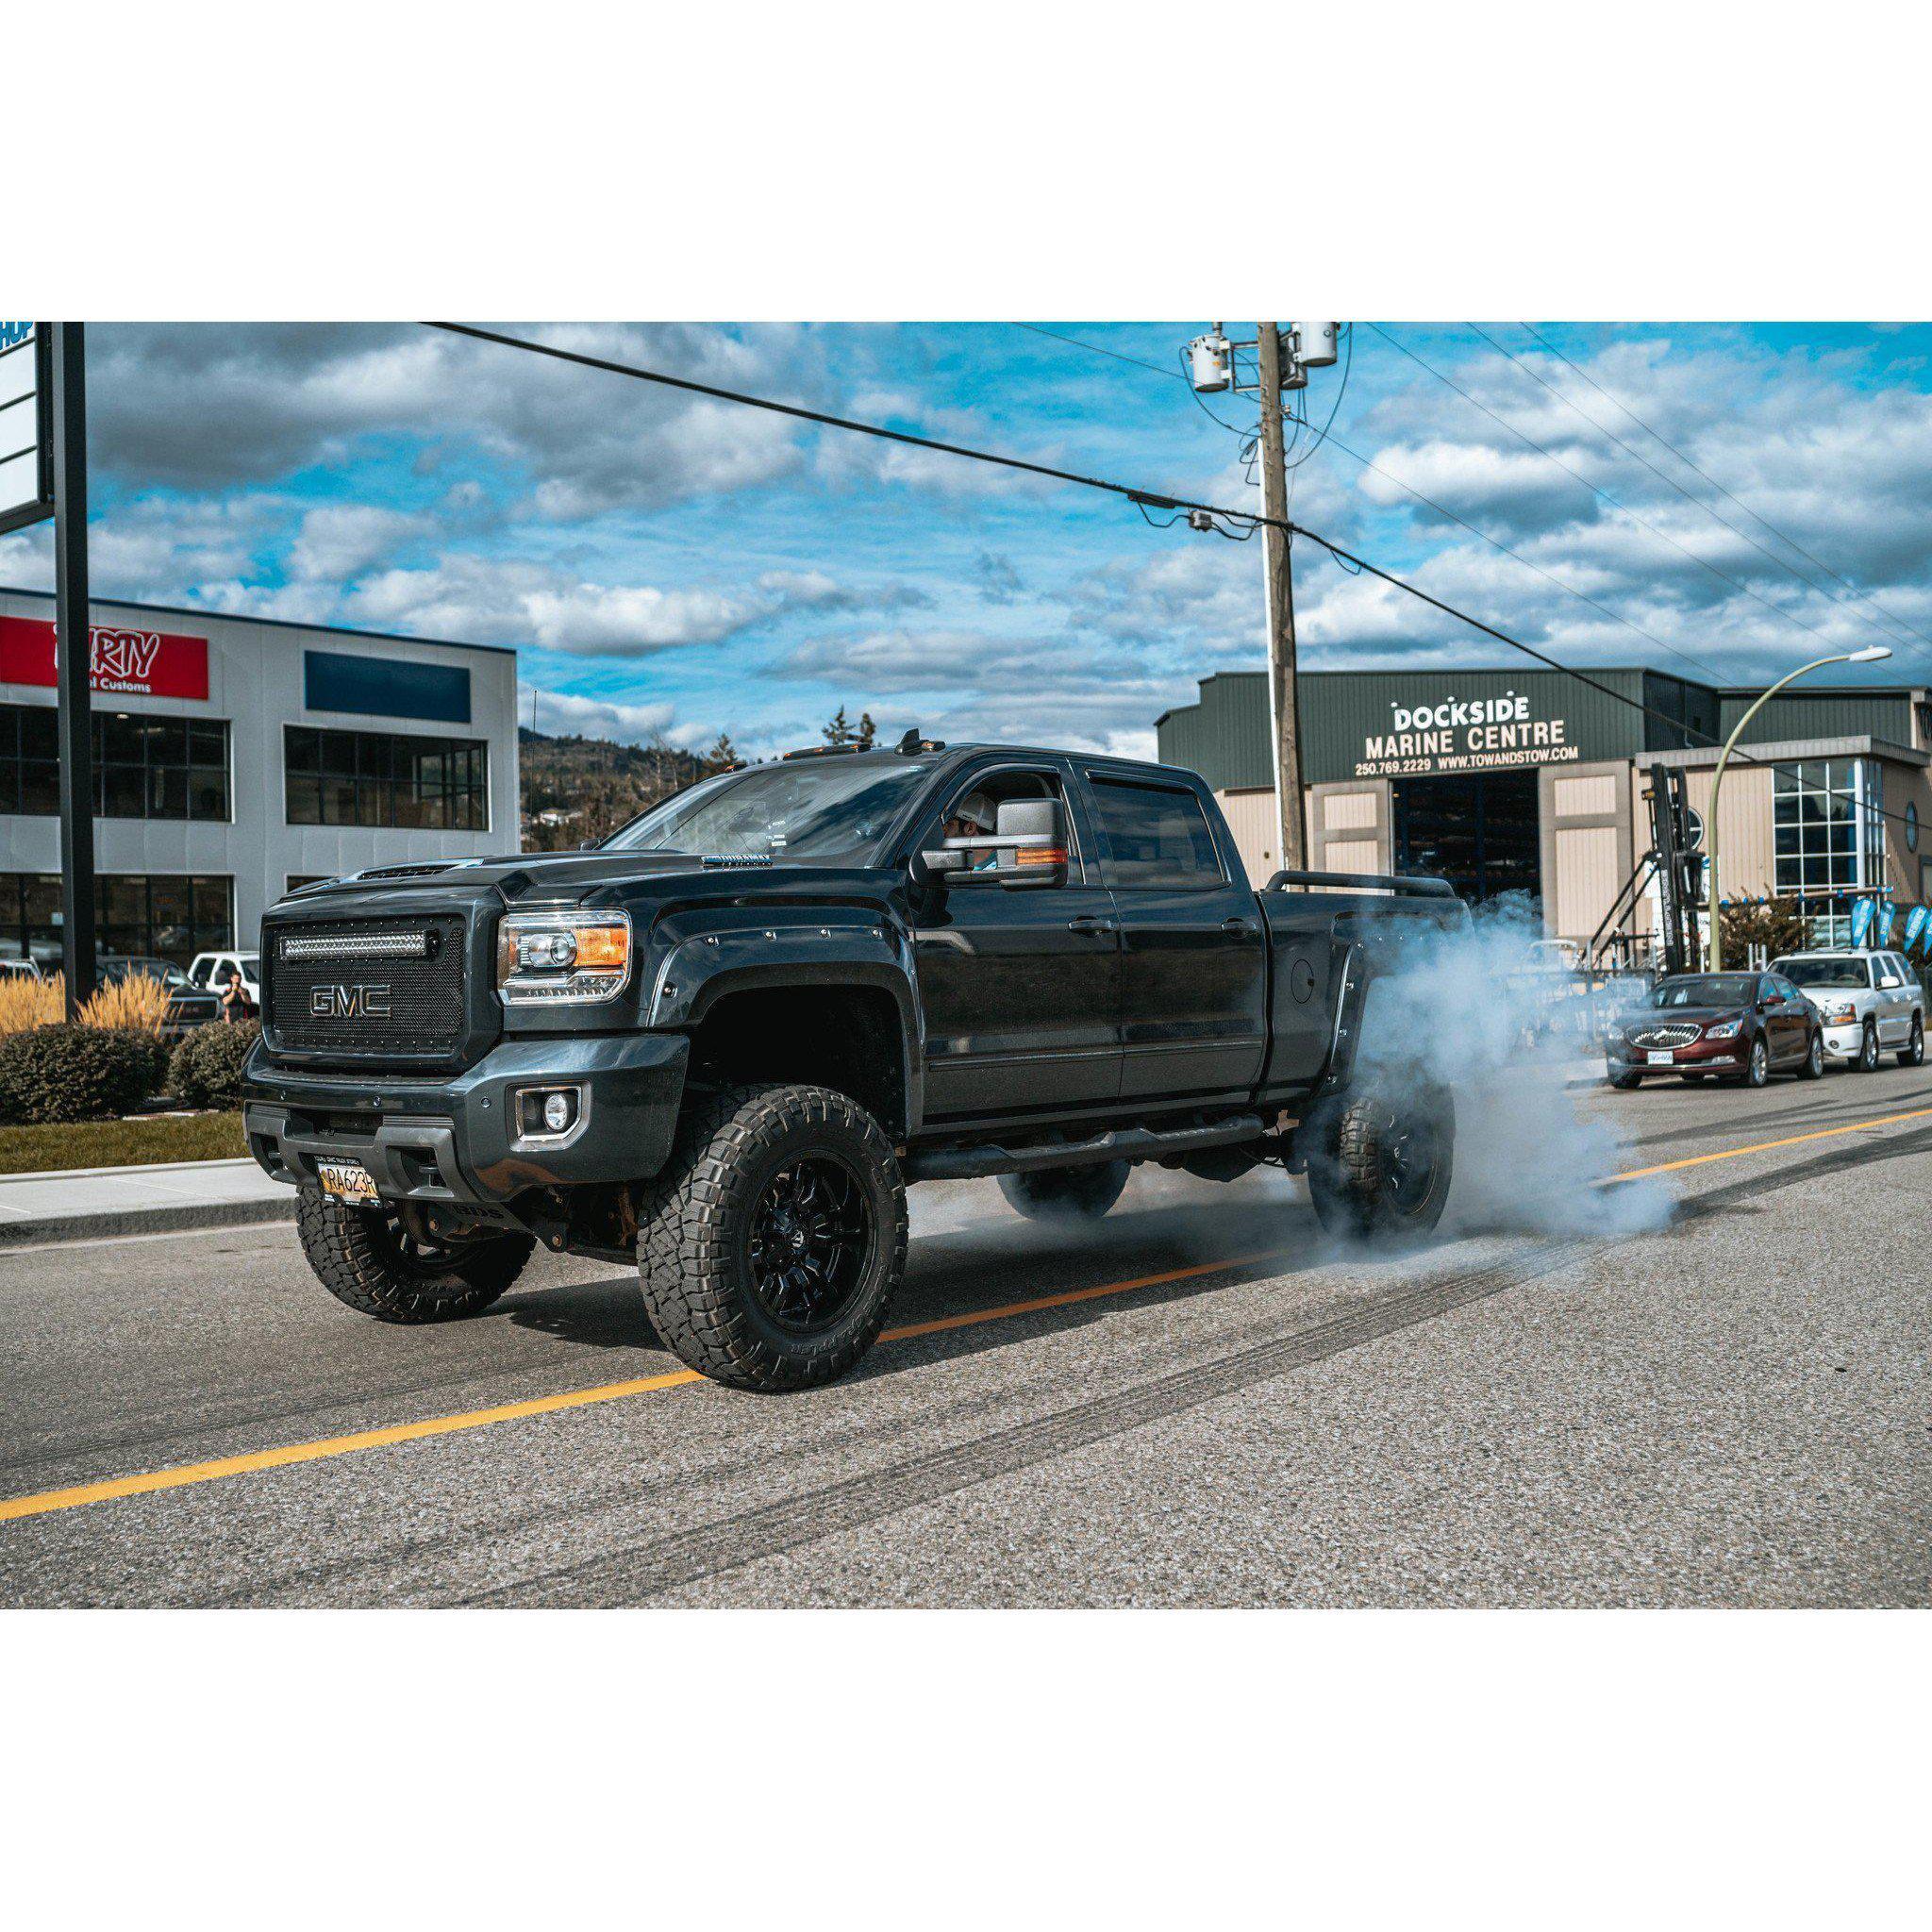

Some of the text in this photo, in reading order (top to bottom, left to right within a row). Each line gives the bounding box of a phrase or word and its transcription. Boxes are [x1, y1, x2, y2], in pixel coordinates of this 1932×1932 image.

[100, 677, 152, 693] Customs
[1393, 696, 1530, 731] DOCKSIDE
[1365, 720, 1565, 759] MARINE CENTRE
[1355, 746, 1578, 776] 250.769.2229 WWW.TOWANDSTOW.COM
[310, 984, 391, 1018] GMC
